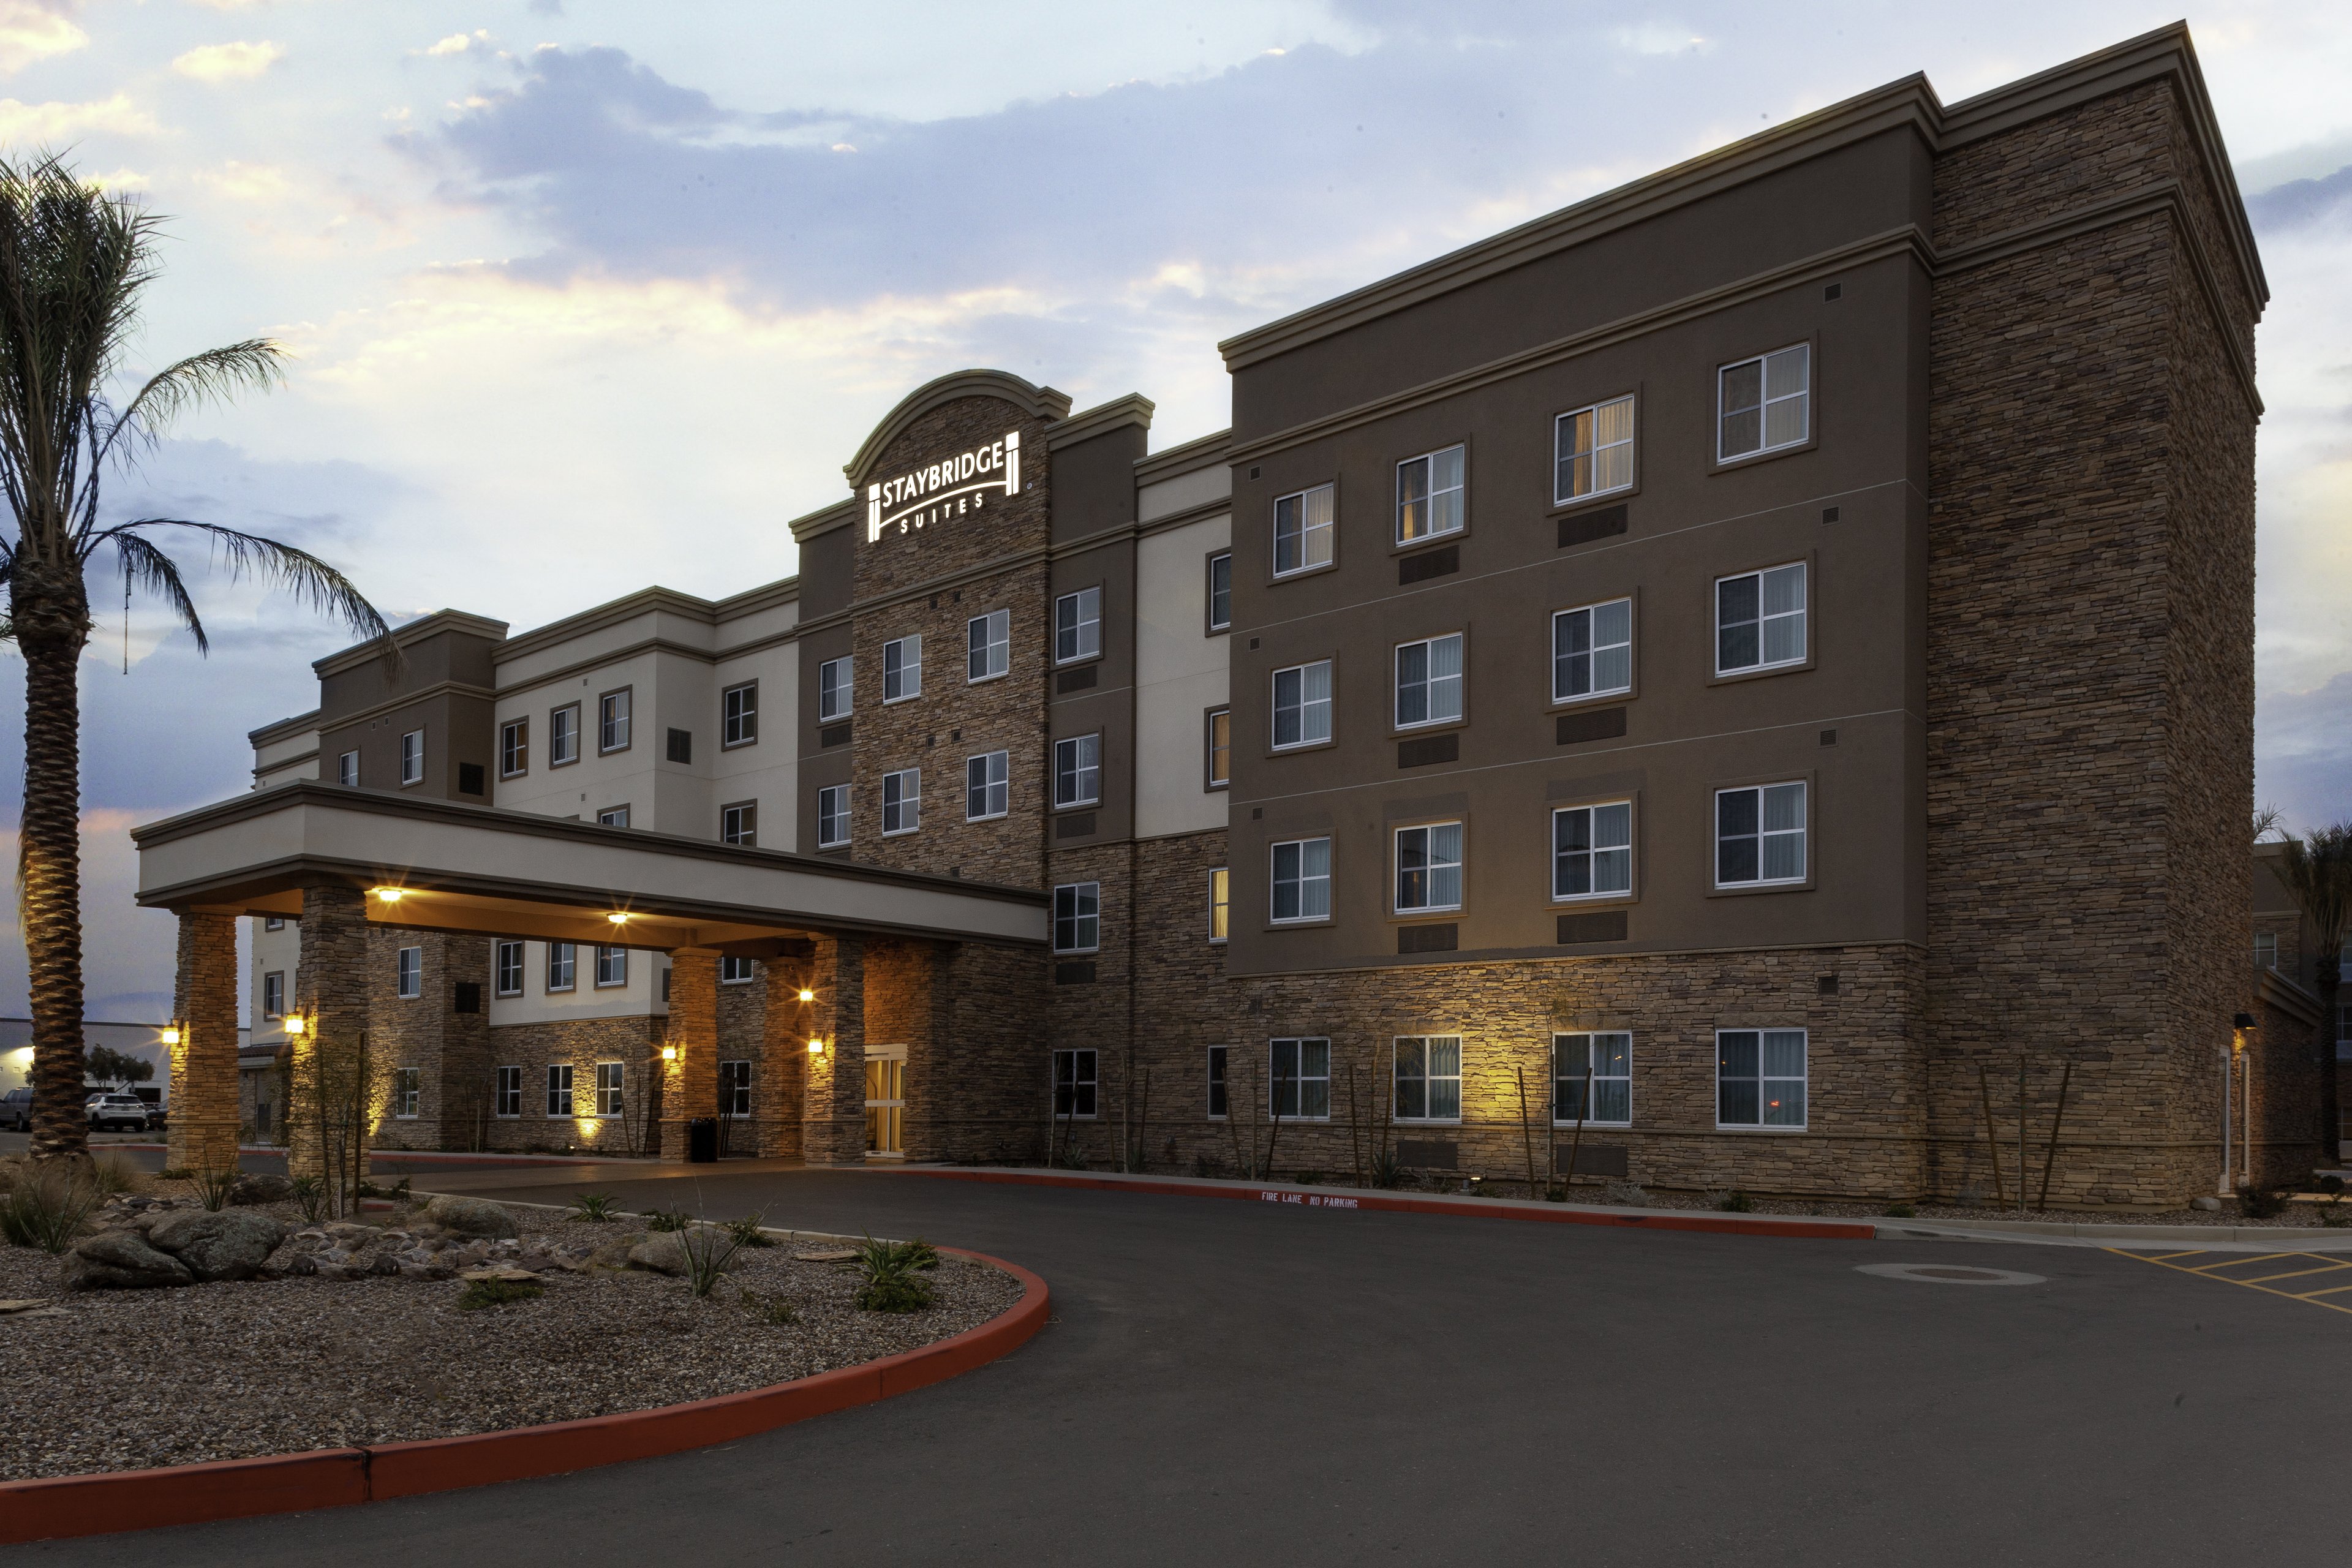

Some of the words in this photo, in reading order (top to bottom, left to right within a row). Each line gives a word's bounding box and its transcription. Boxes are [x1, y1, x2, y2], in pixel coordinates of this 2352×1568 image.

[883, 440, 1003, 508] STAYBRIDGE
[900, 492, 982, 534] SUITES
[1262, 1191, 1278, 1201] FIRE
[1282, 1193, 1302, 1204] LANE
[1310, 1196, 1320, 1205] NO
[1324, 1197, 1358, 1208] PARKING
